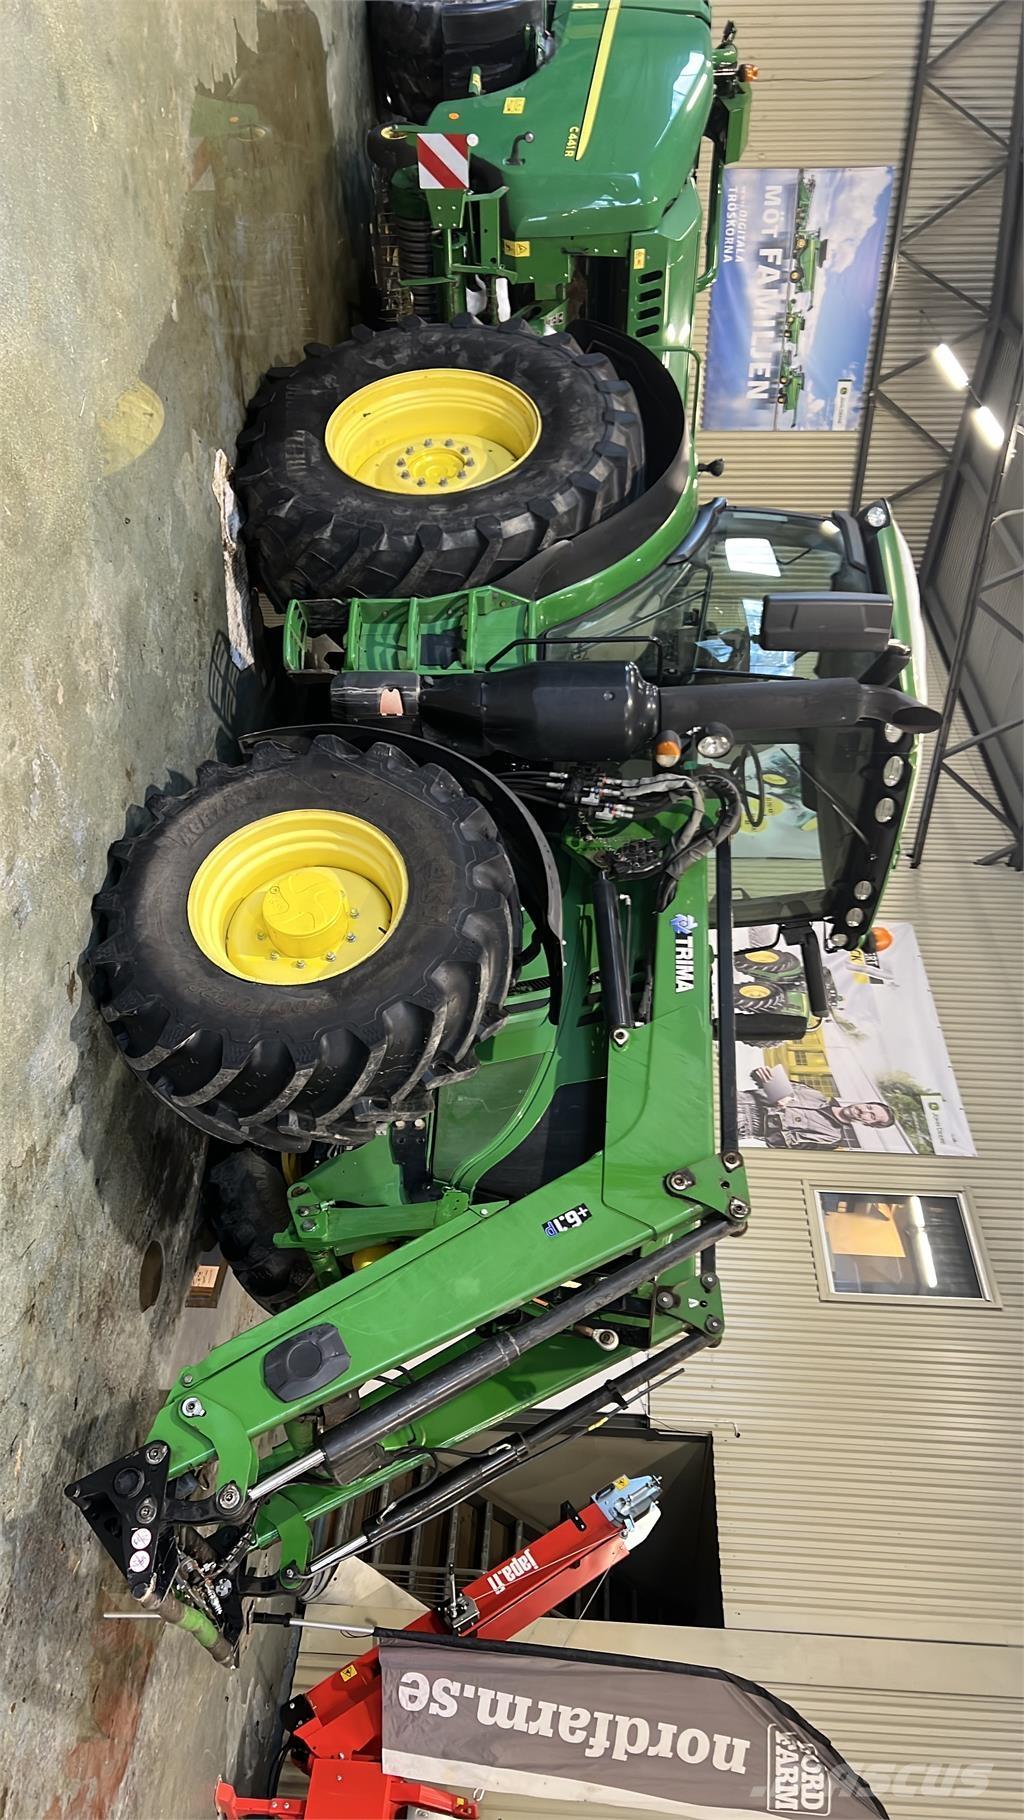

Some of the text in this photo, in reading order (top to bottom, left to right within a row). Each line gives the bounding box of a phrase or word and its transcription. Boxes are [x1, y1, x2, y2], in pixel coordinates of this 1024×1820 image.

[723, 187, 739, 262] TRÖSKORNA
[735, 210, 748, 262] DIGITALA
[746, 186, 783, 399] MÖT FAMILJEN
[676, 936, 694, 992] TRIMA
[398, 1672, 751, 1774] nordfarm.se
[775, 1730, 798, 1810] FARM
